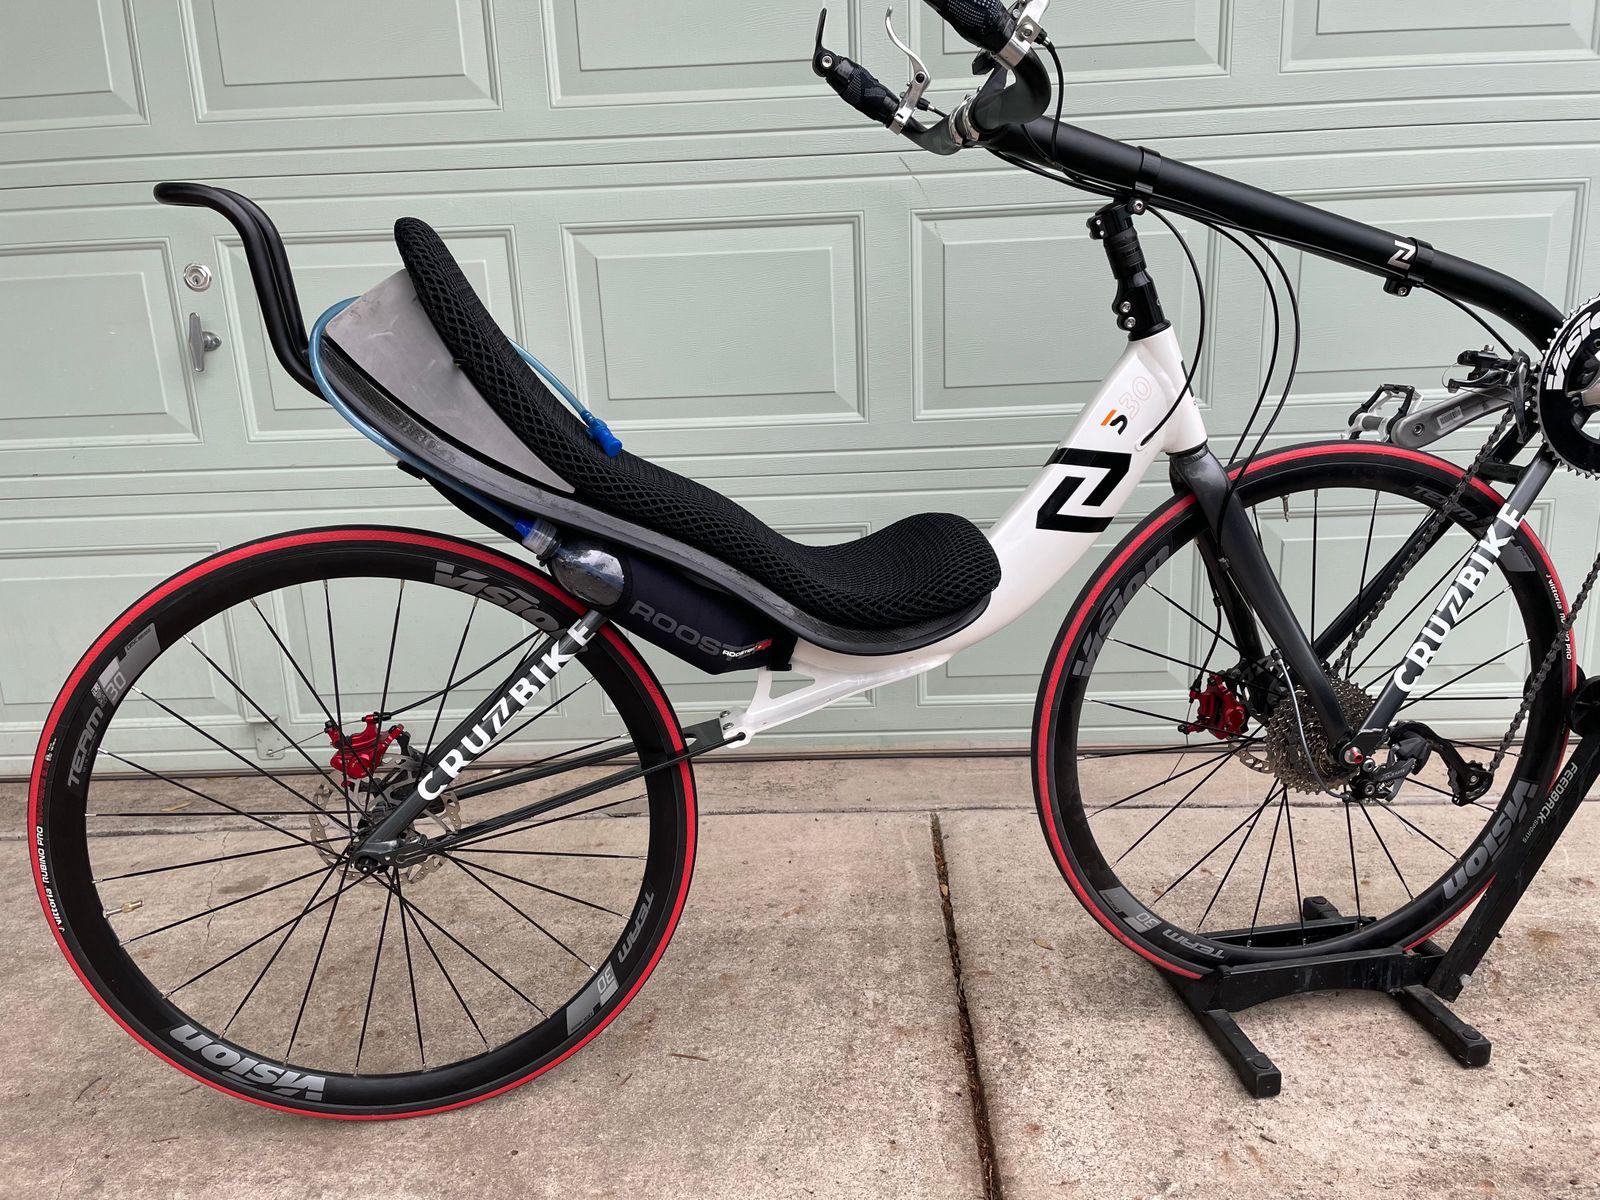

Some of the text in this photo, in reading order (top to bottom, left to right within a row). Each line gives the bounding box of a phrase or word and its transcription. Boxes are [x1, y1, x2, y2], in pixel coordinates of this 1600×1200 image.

[1394, 503, 1525, 693] CRUZBIKE
[67, 706, 104, 787] TEAM
[106, 671, 126, 701] 30
[417, 618, 597, 800] CRUZBIKE
[1538, 762, 1578, 824] FEEDBACK
[36, 826, 44, 847] PRO
[37, 848, 50, 883] RUBINO
[46, 886, 62, 926] vittoria
[1136, 912, 1226, 960] TEAM 30
[597, 890, 655, 994] TEAM 30
